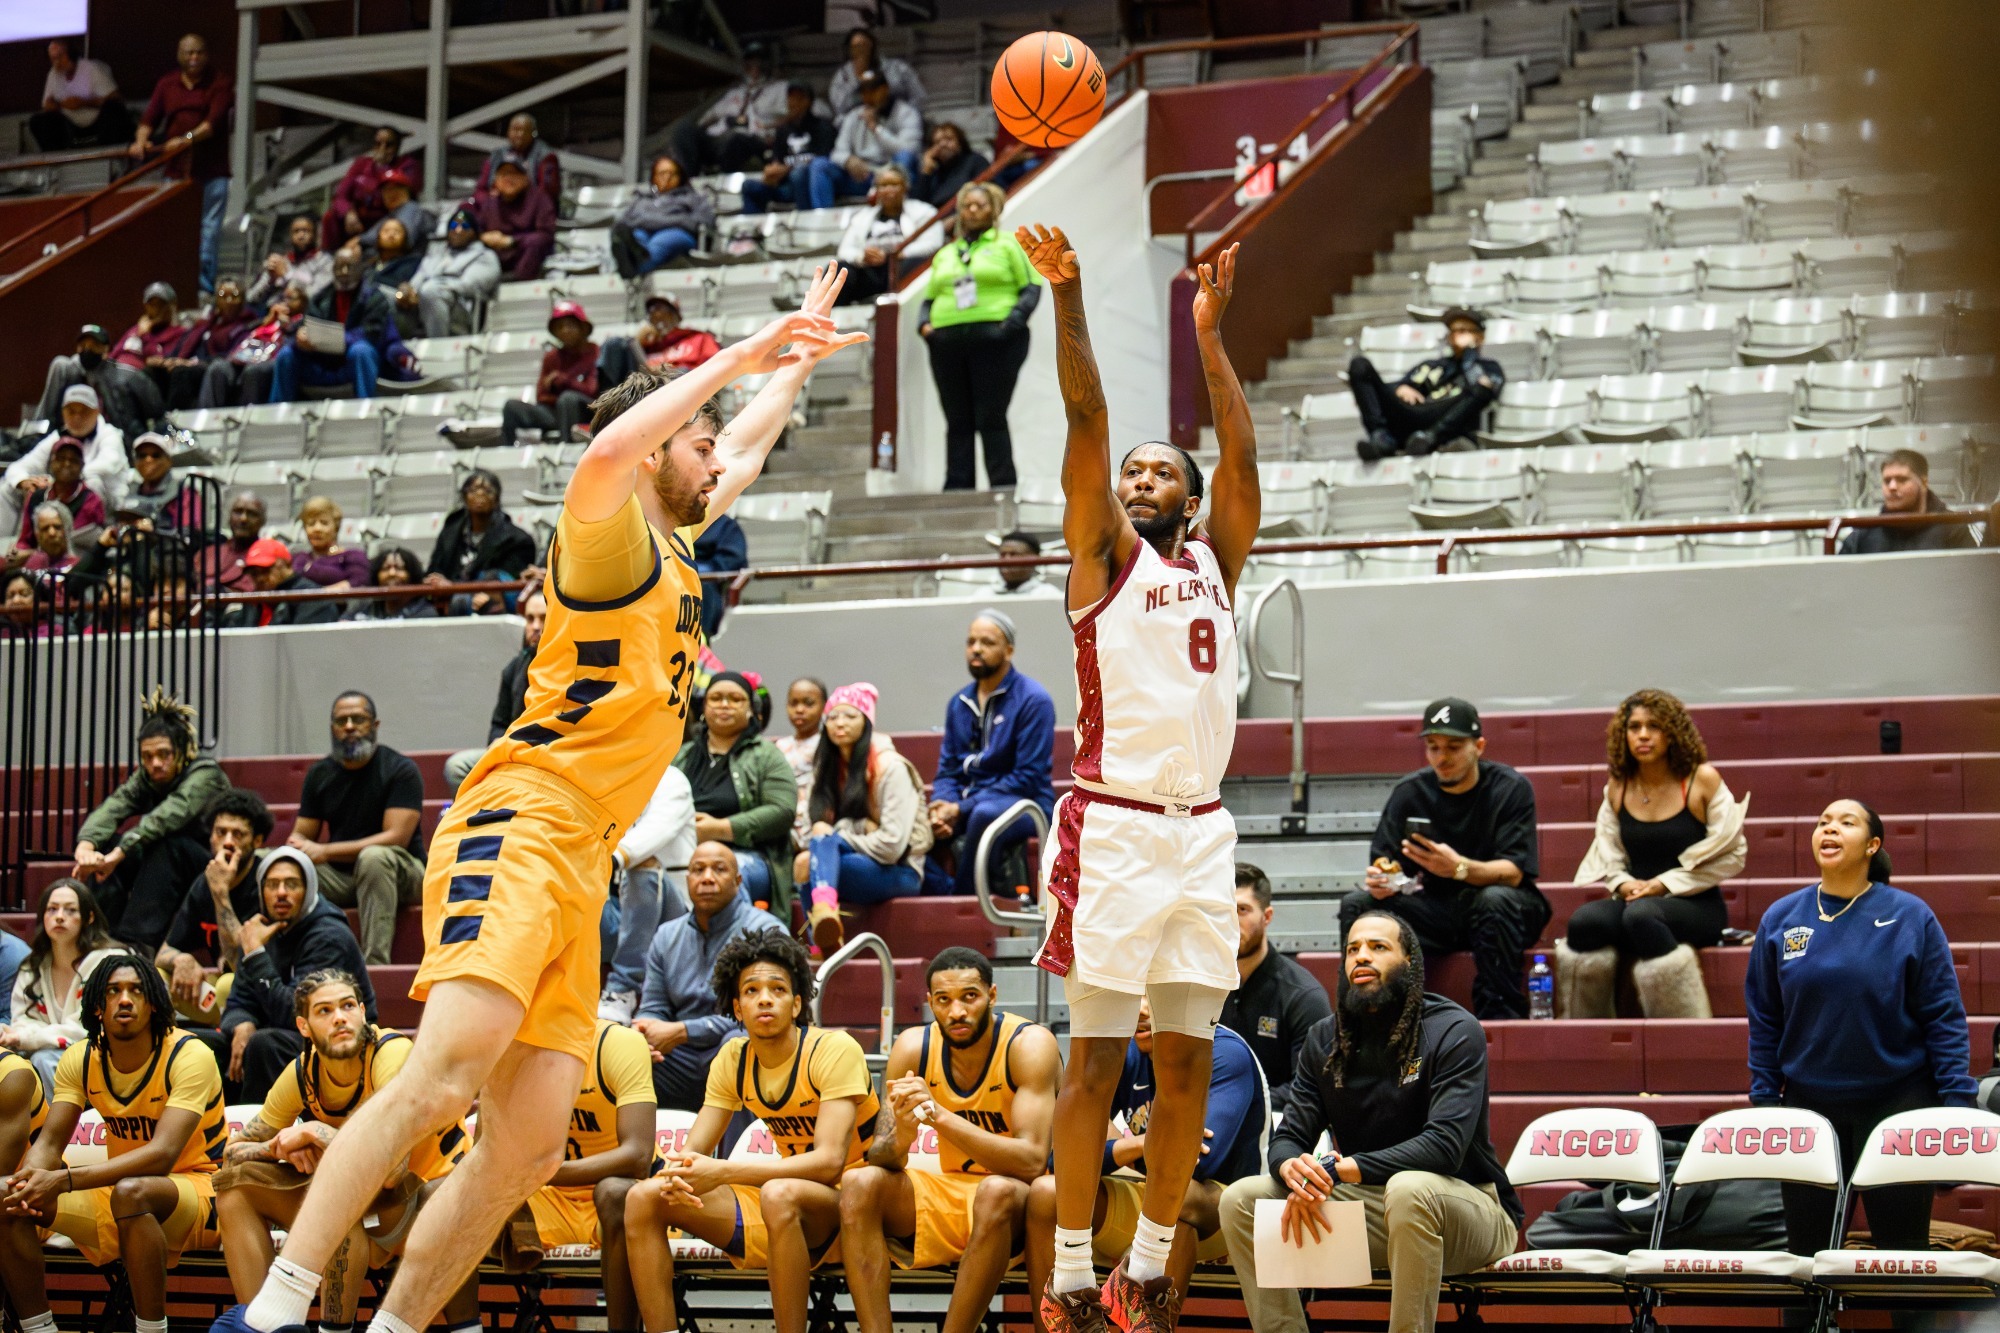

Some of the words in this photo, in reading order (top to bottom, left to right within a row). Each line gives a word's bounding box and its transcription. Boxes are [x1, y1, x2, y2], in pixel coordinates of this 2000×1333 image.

[1145, 584, 1170, 614] NC
[1188, 617, 1217, 674] 8
[1529, 1128, 1643, 1158] NCCU
[1702, 1126, 1819, 1156] NCCU
[1881, 1126, 2000, 1157] NCCU
[1663, 1258, 1744, 1274] EAGLES
[1854, 1259, 1938, 1275] EAGLES
